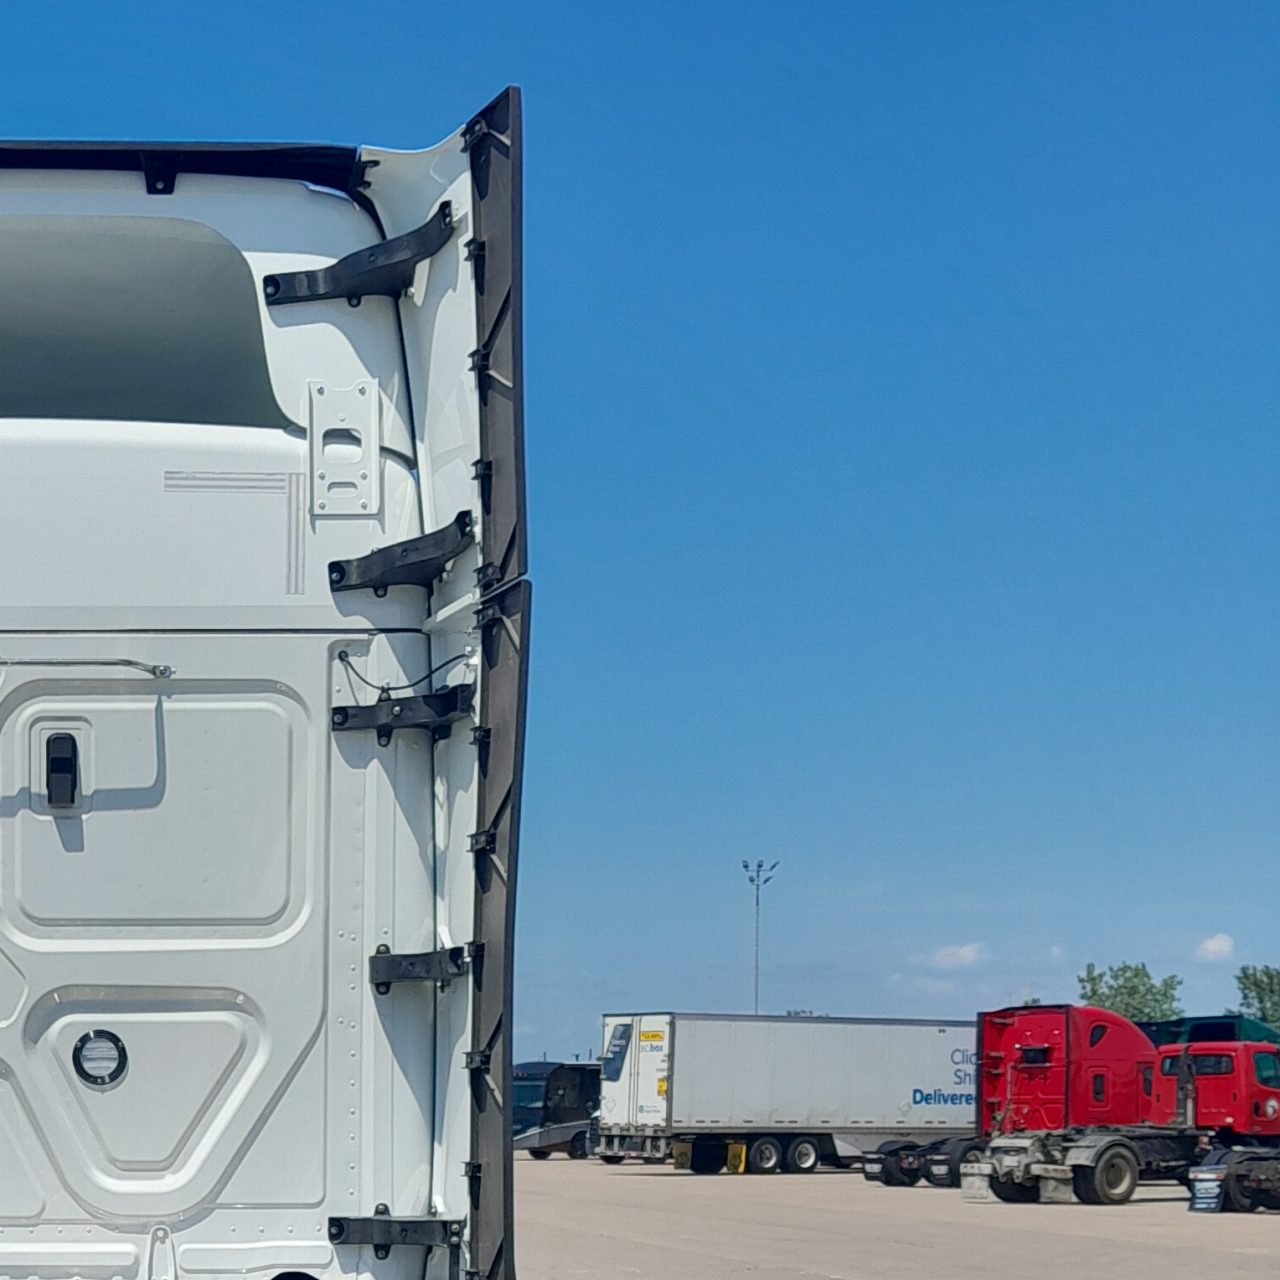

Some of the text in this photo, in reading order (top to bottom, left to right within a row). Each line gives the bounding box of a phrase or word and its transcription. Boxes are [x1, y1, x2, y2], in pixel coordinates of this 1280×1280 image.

[950, 1047, 978, 1066] Clic
[953, 1068, 977, 1086] Shi
[912, 1088, 975, 1106] Delivere
